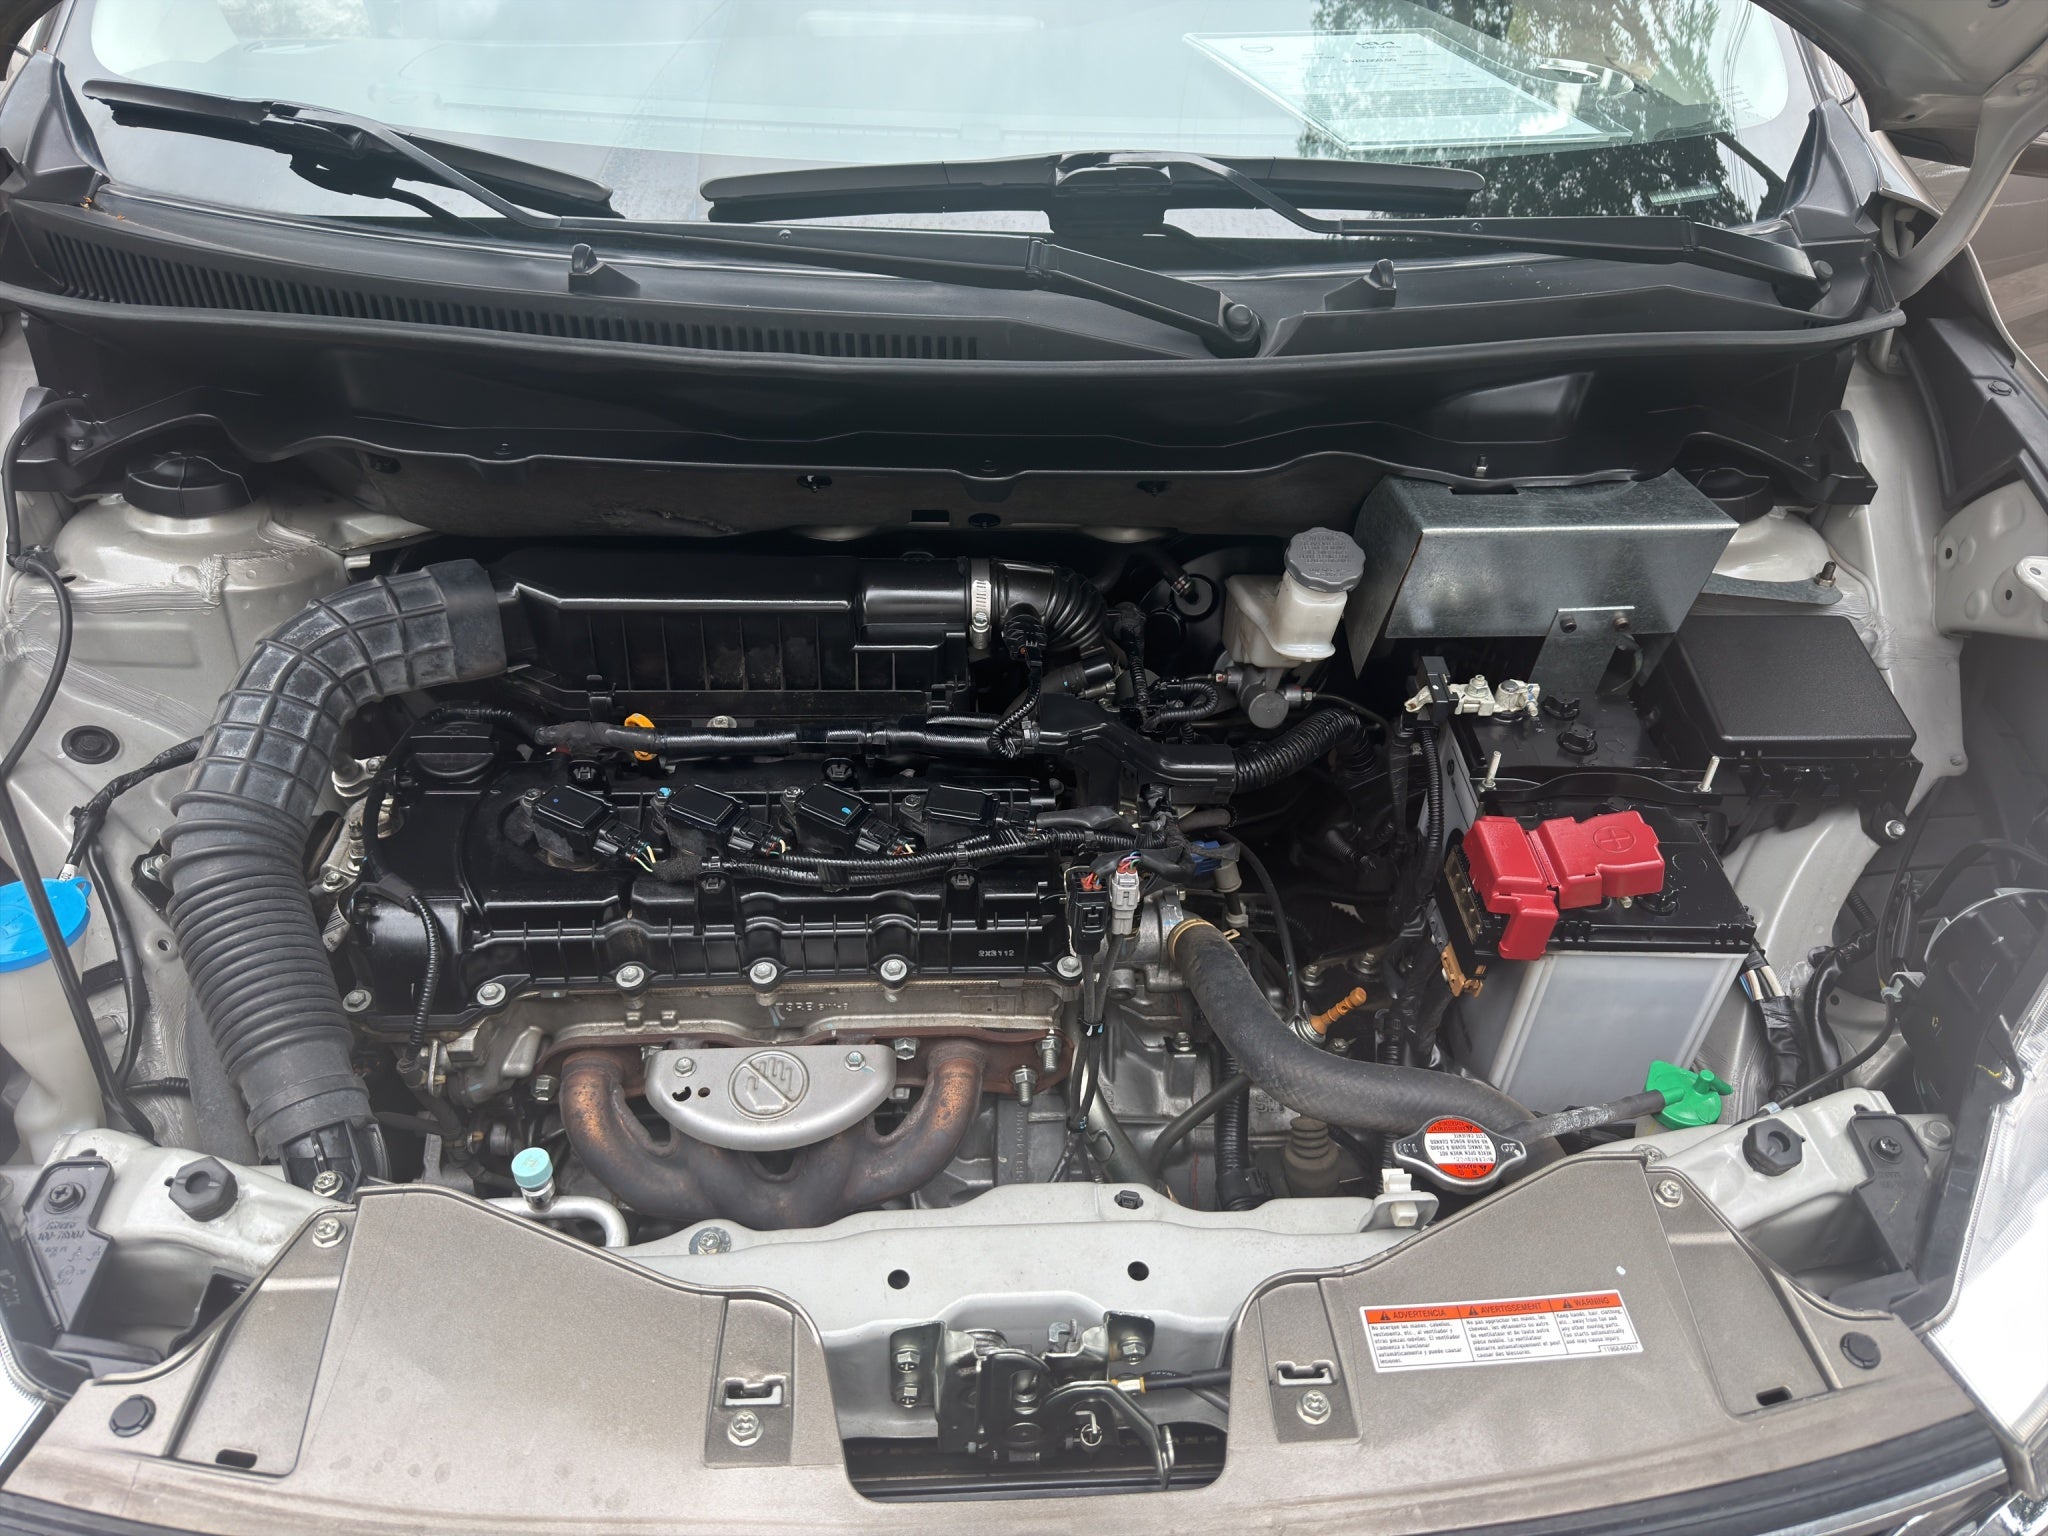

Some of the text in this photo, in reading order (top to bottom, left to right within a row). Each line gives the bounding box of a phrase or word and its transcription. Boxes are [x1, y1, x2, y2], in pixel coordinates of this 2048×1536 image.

[1575, 1297, 1610, 1306] WARNING
[1481, 1303, 1542, 1314] AVERTISSEMENT
[1393, 1309, 1447, 1319] ADVERTENCIA
